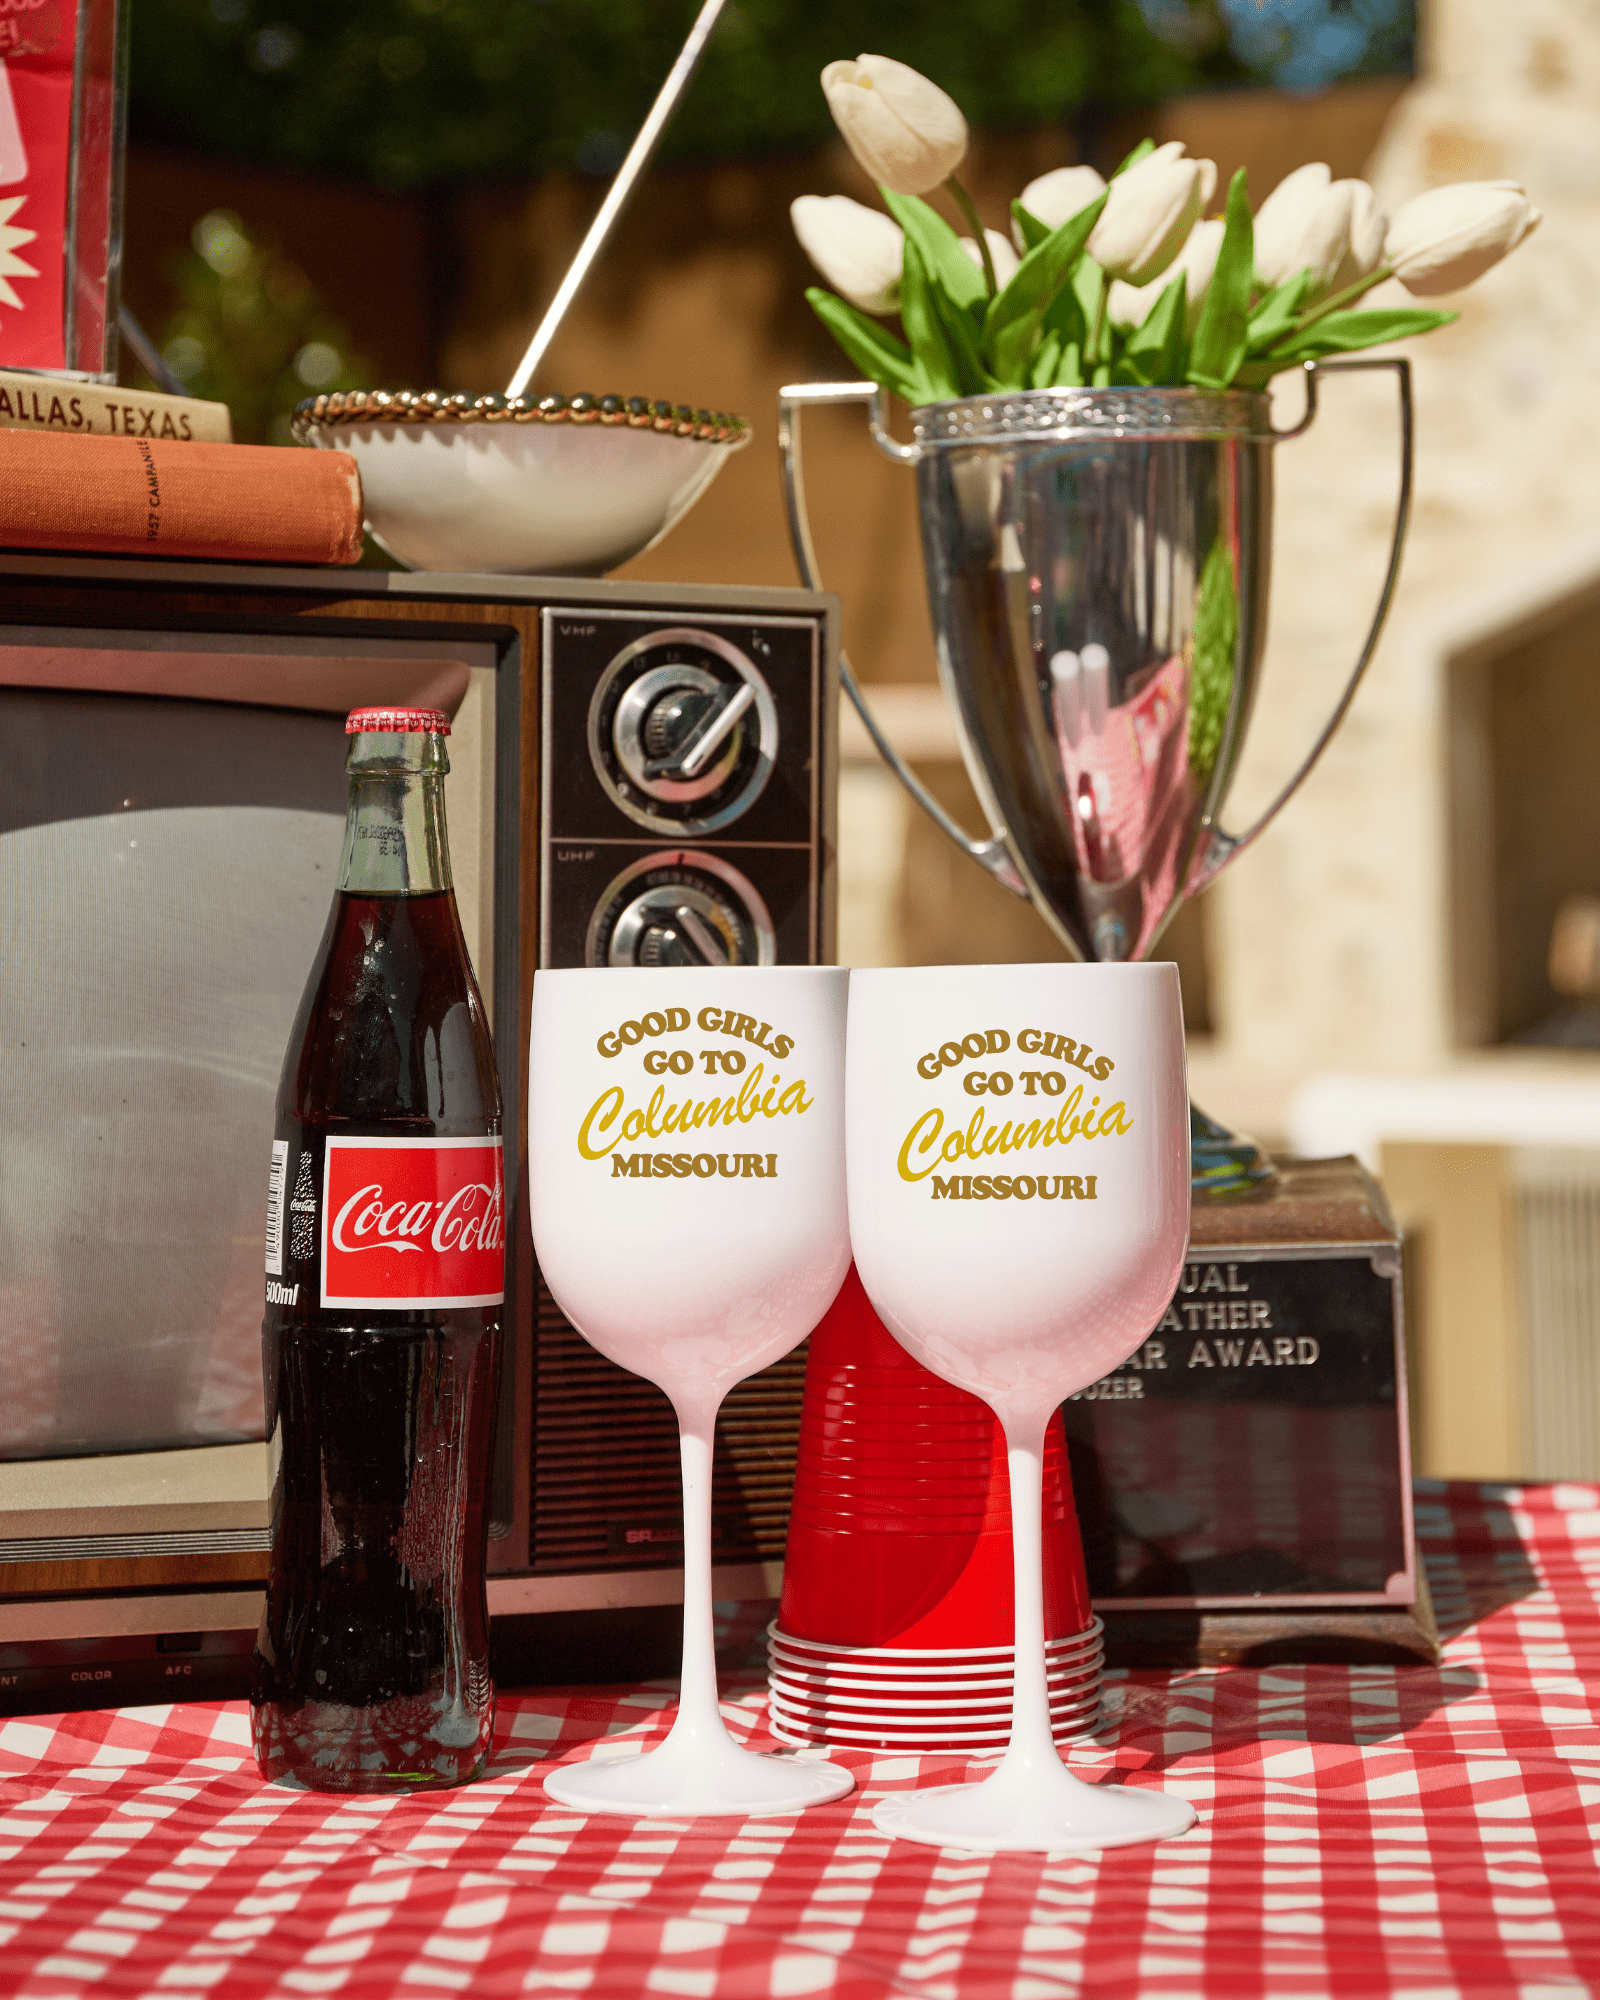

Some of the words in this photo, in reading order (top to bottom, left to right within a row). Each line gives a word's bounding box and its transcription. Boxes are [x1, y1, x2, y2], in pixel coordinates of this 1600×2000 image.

[105, 403, 192, 441] TEXAS
[137, 440, 160, 508] CAMPANILE
[146, 513, 160, 542] 1957
[559, 625, 597, 636] VHF
[557, 851, 596, 862] UHF
[597, 1007, 691, 1058] GOOD
[697, 1007, 795, 1059] GIRLS
[643, 1050, 694, 1075] GO
[699, 1050, 746, 1075] TO
[917, 1029, 1011, 1080] GOOD
[1016, 1029, 1115, 1081] GIRLS
[963, 1071, 1014, 1096] GO
[1019, 1071, 1067, 1096] TO
[577, 1062, 814, 1160] Columbia
[897, 1084, 1134, 1182] Columbia
[611, 1153, 778, 1178] MISSOURI
[931, 1175, 1098, 1200] MISSOURI
[332, 1184, 502, 1253] Coca-Cola
[265, 1280, 299, 1306] 500ml
[1187, 1336, 1320, 1368] AWARD
[1068, 1376, 1145, 1400] UZER
[71, 1670, 112, 1682] COLOR
[165, 1665, 192, 1676] AFC
